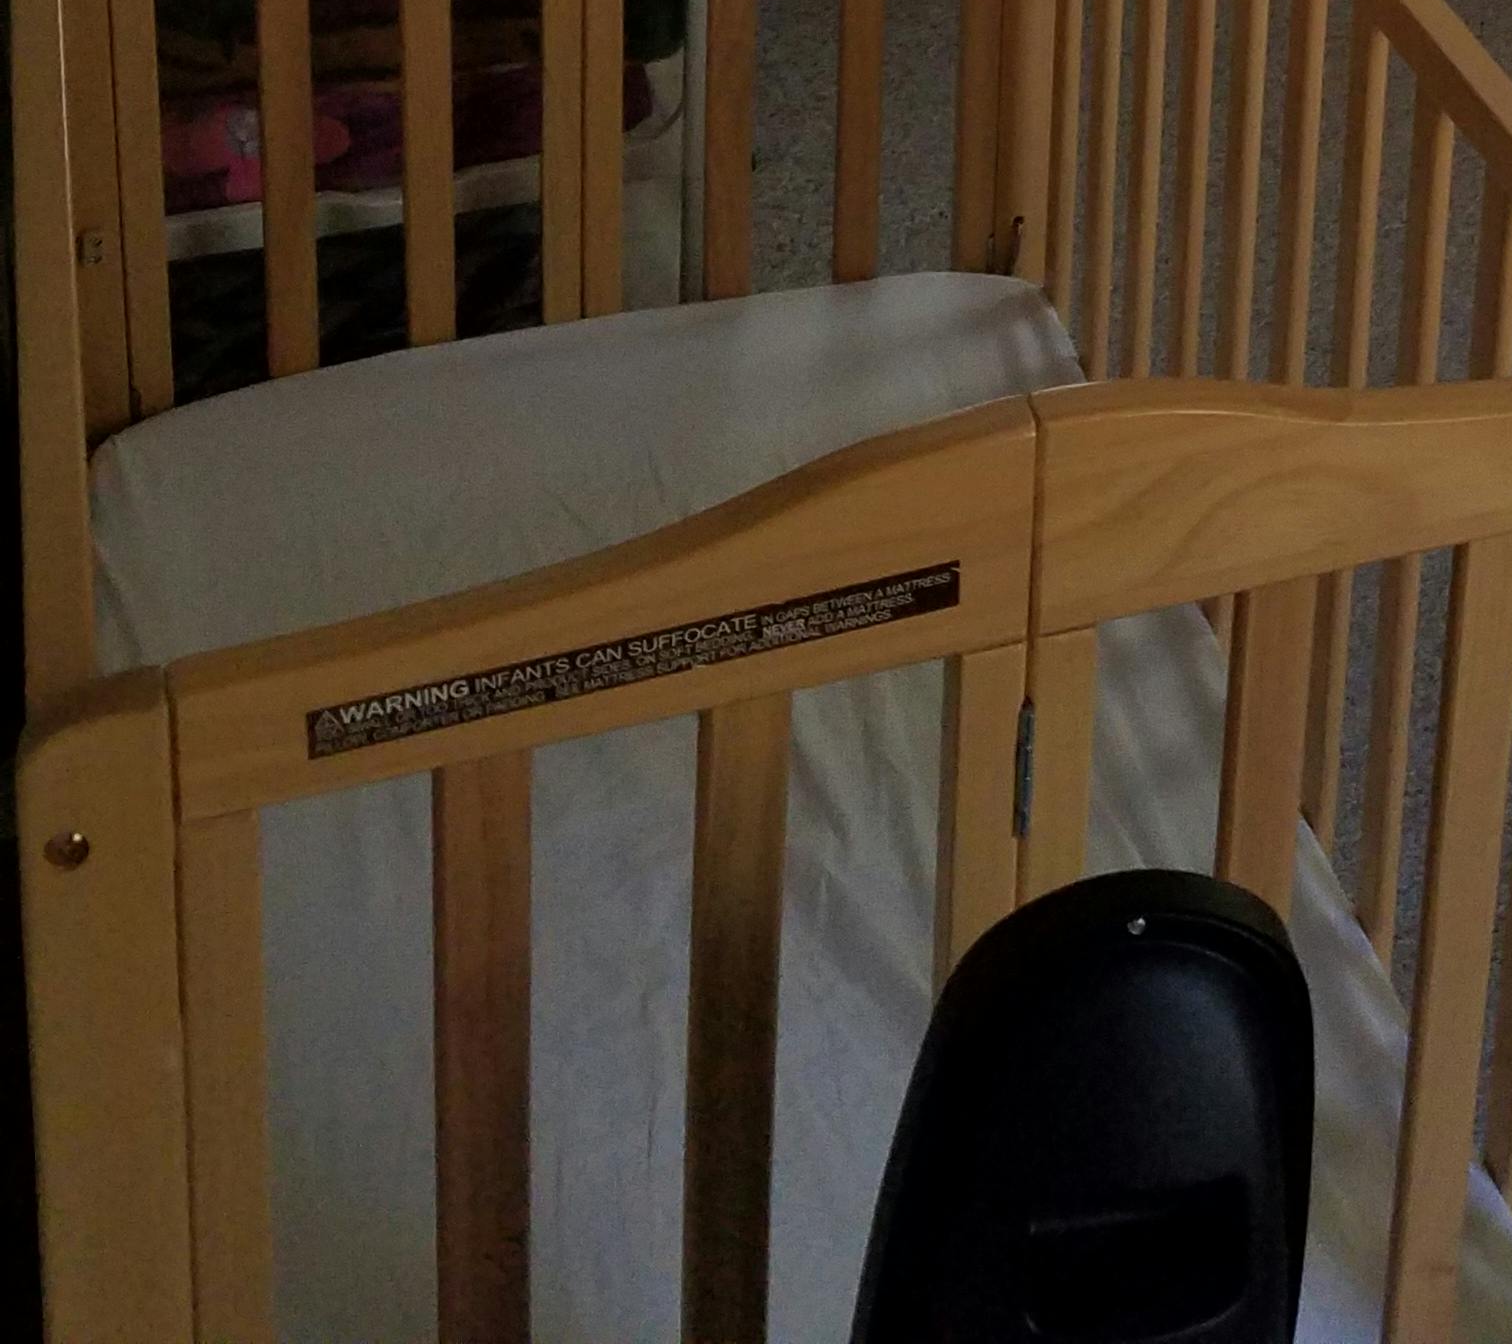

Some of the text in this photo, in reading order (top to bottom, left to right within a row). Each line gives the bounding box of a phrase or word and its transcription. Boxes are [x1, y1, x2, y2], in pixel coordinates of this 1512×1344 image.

[339, 677, 470, 725] WARNING
[474, 655, 570, 694] INFANTS
[574, 643, 623, 670] CAN
[625, 612, 757, 658] SUFFOCATE
